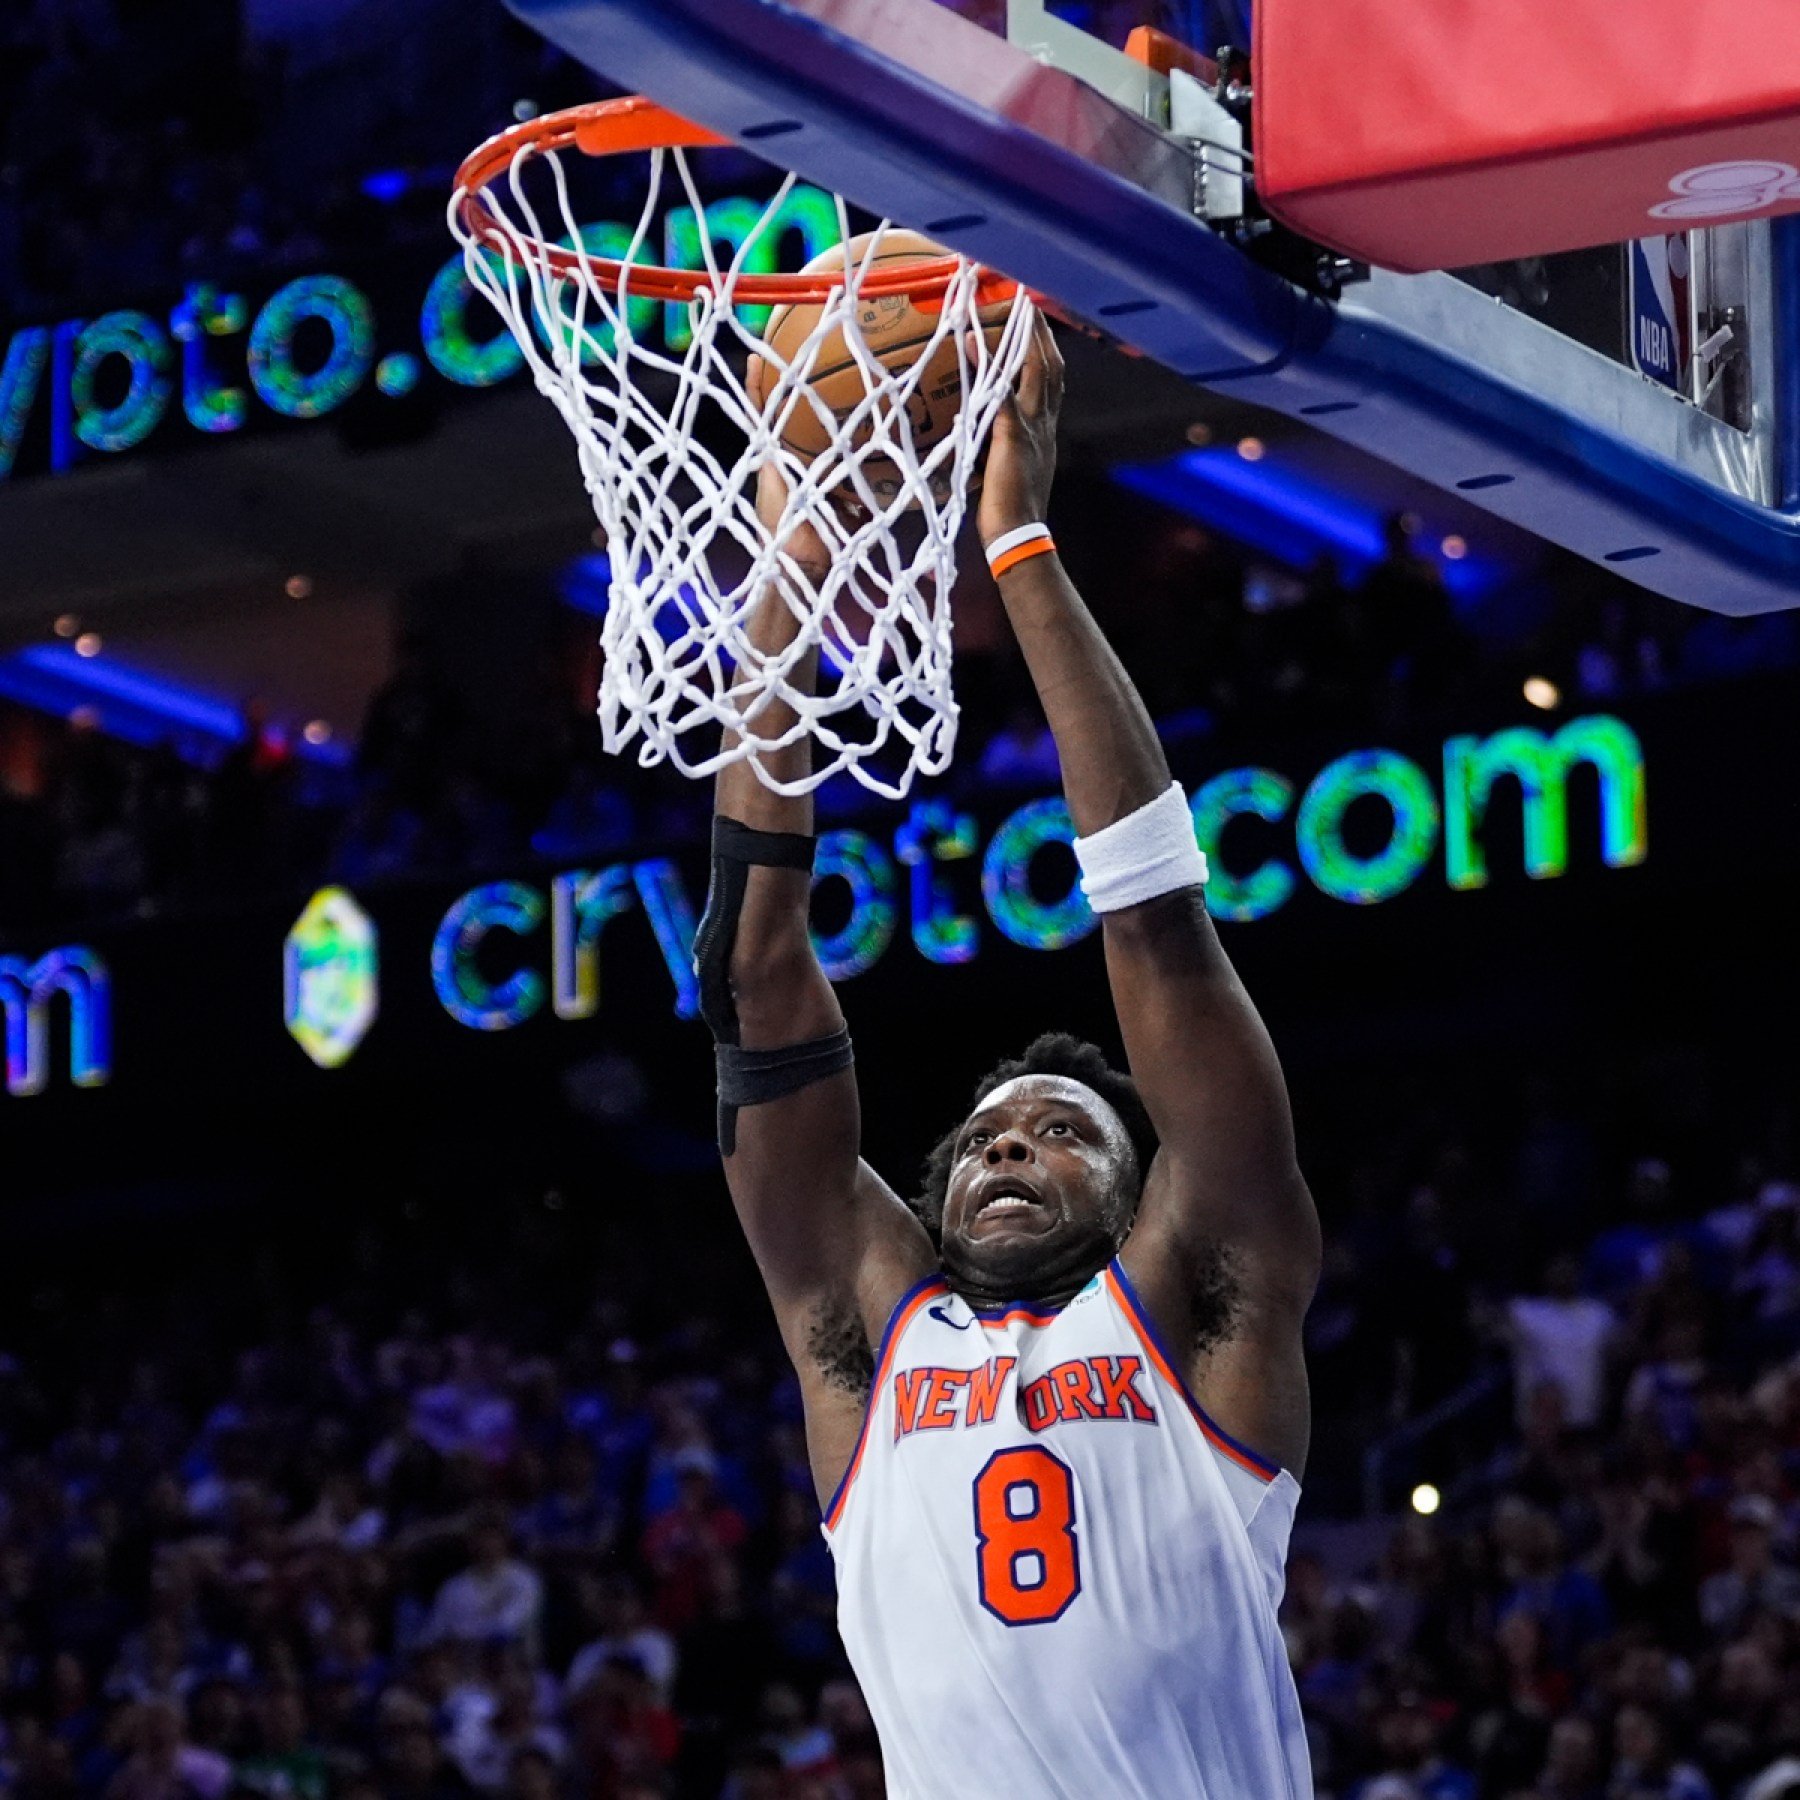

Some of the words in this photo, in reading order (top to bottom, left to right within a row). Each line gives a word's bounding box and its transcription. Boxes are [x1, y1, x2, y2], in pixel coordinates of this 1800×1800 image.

[1640, 314, 1669, 373] NBA
[894, 1355, 1018, 1449] NEW
[1021, 1355, 1159, 1434] ORK
[971, 1443, 1082, 1627] 8
